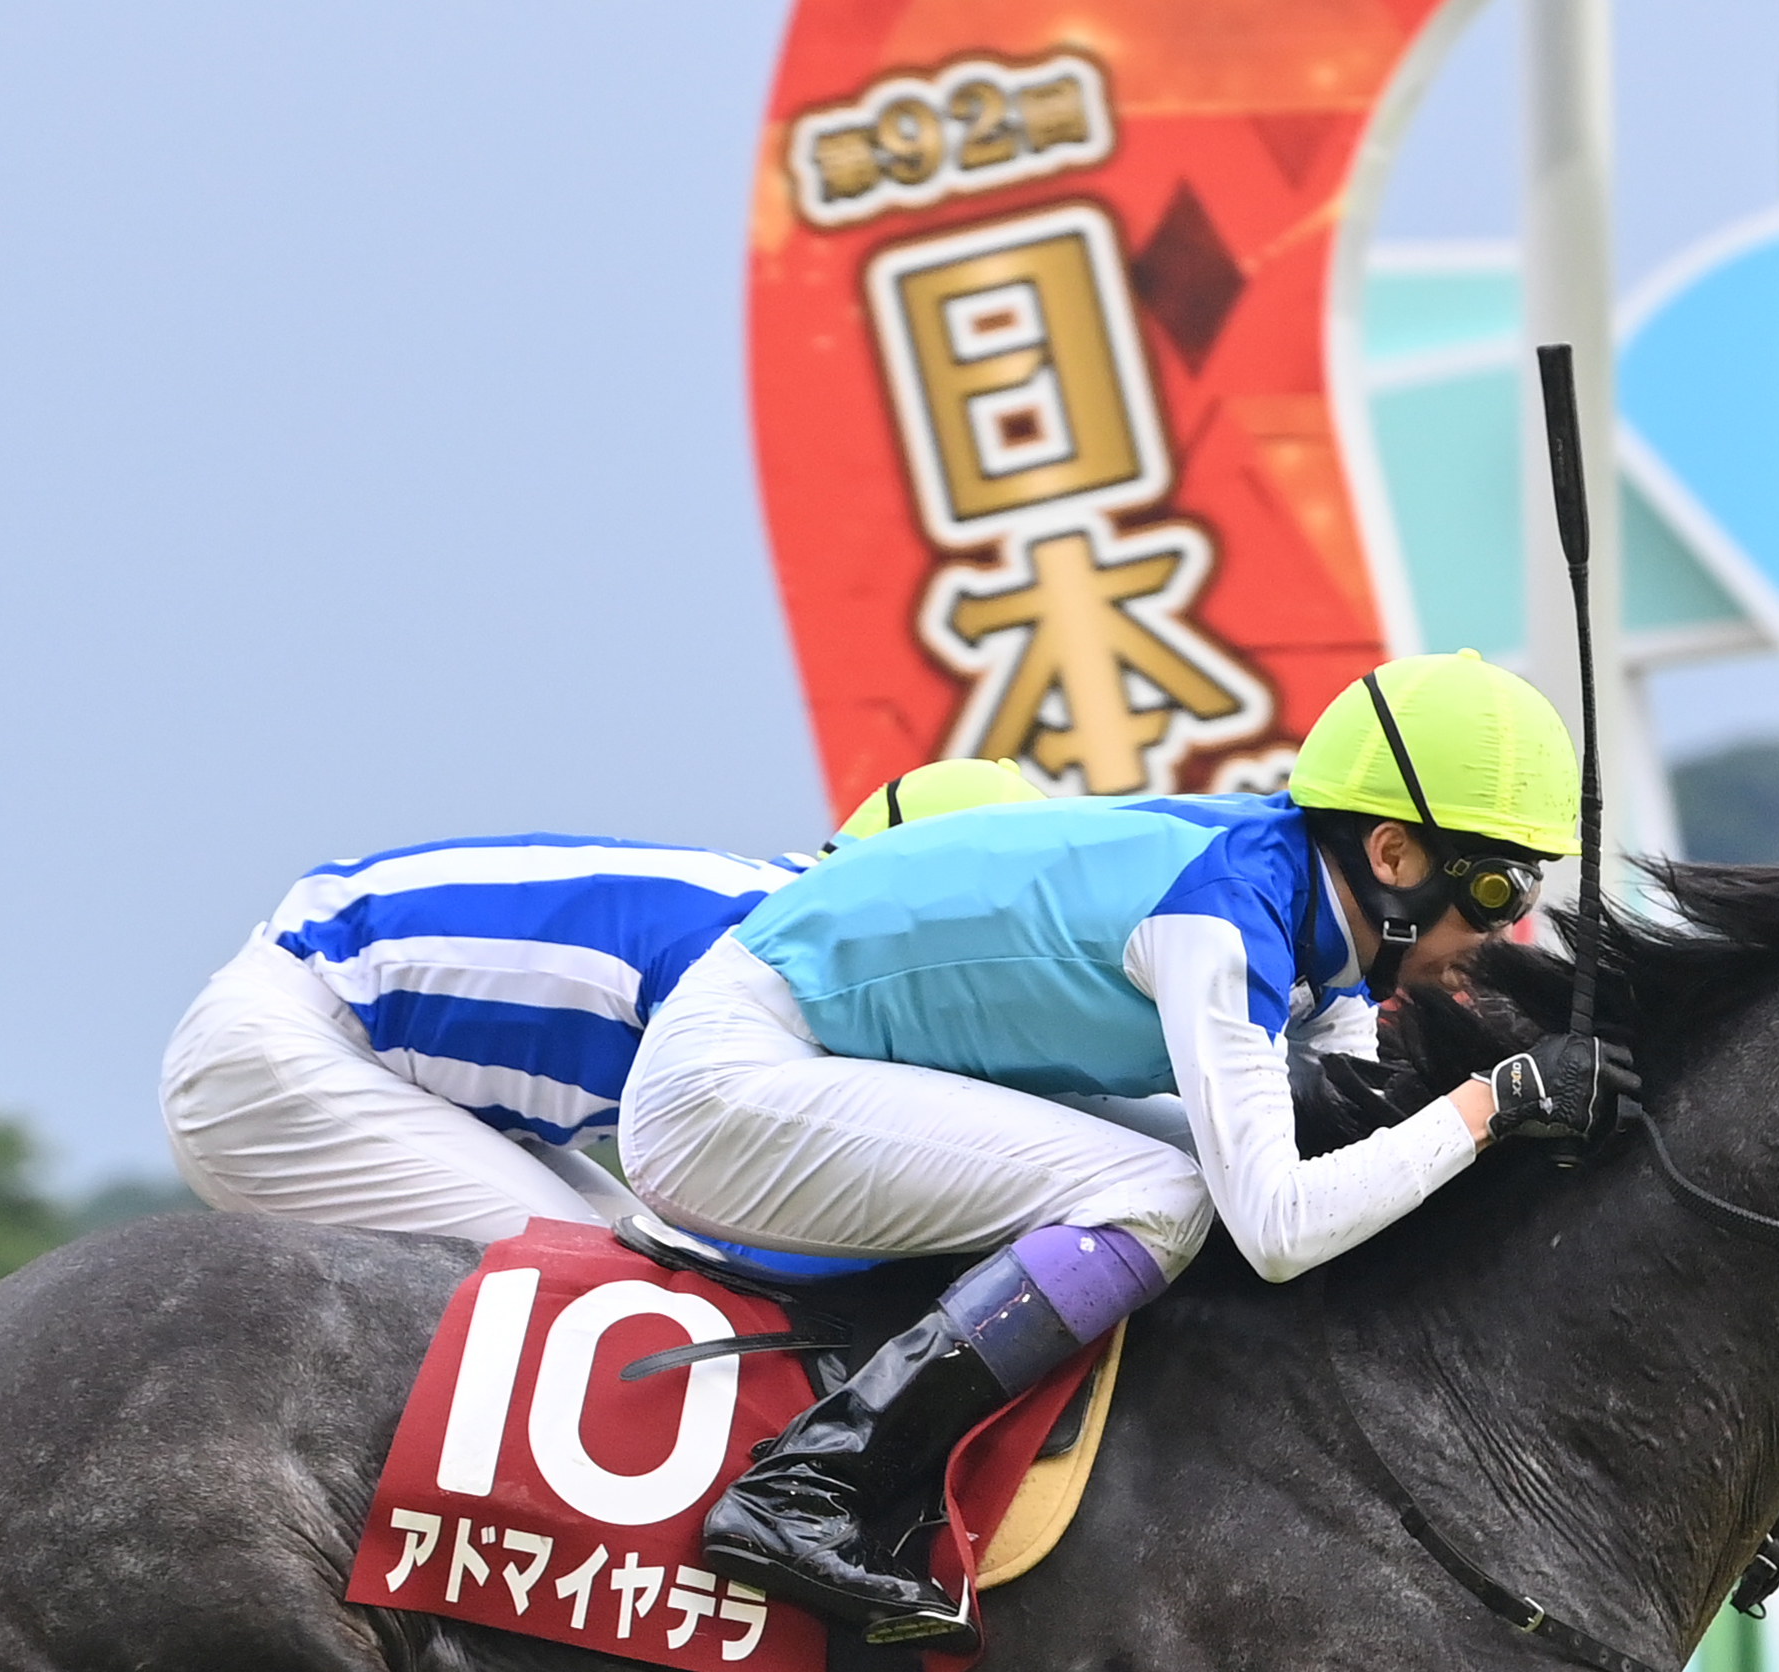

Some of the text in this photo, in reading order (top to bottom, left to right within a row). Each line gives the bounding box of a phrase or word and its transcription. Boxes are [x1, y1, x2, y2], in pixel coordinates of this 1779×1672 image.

[435, 1266, 741, 1527] 10
[384, 1506, 770, 1662] アドマイヤテラ
